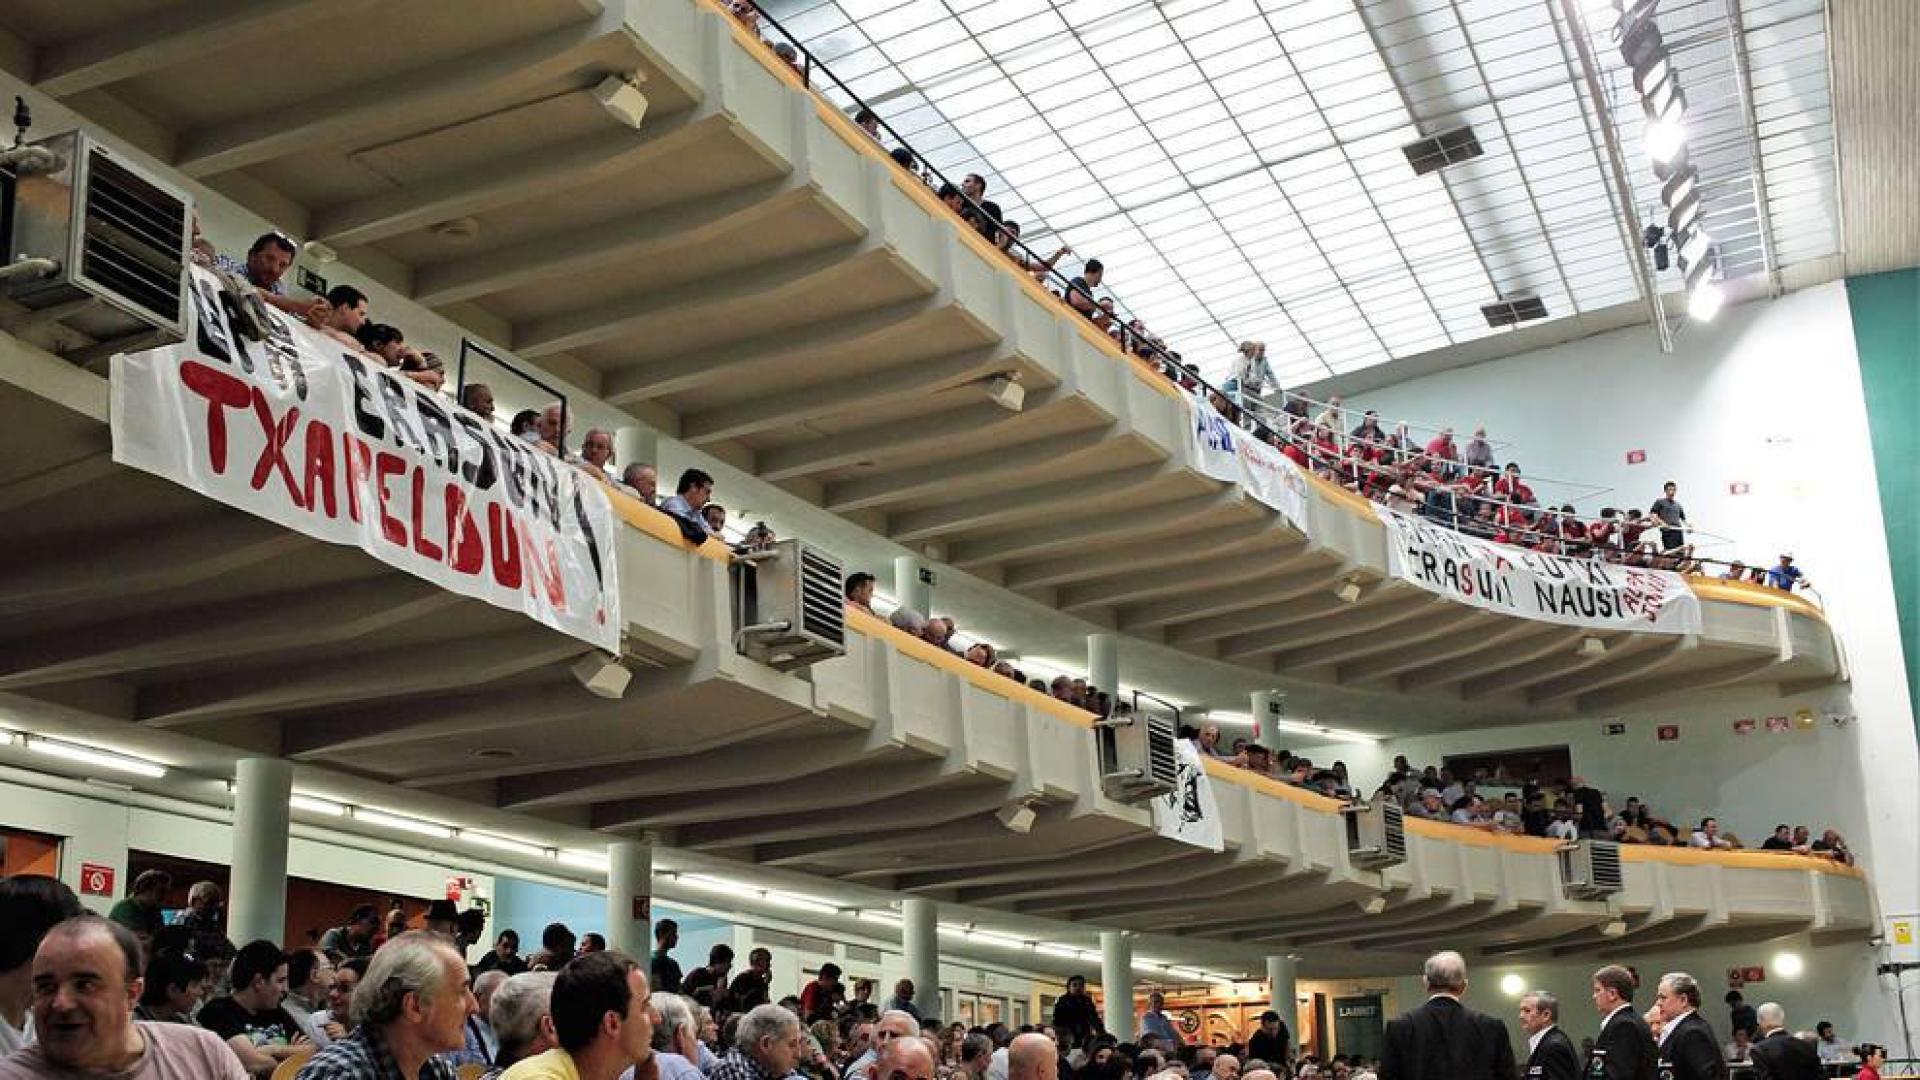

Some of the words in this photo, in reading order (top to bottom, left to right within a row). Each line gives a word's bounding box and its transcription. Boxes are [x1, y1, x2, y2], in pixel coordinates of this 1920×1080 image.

[180, 359, 568, 614] TXAPELDUN
[342, 352, 561, 534] ERASUN
[1533, 580, 1624, 619] NAUSI
